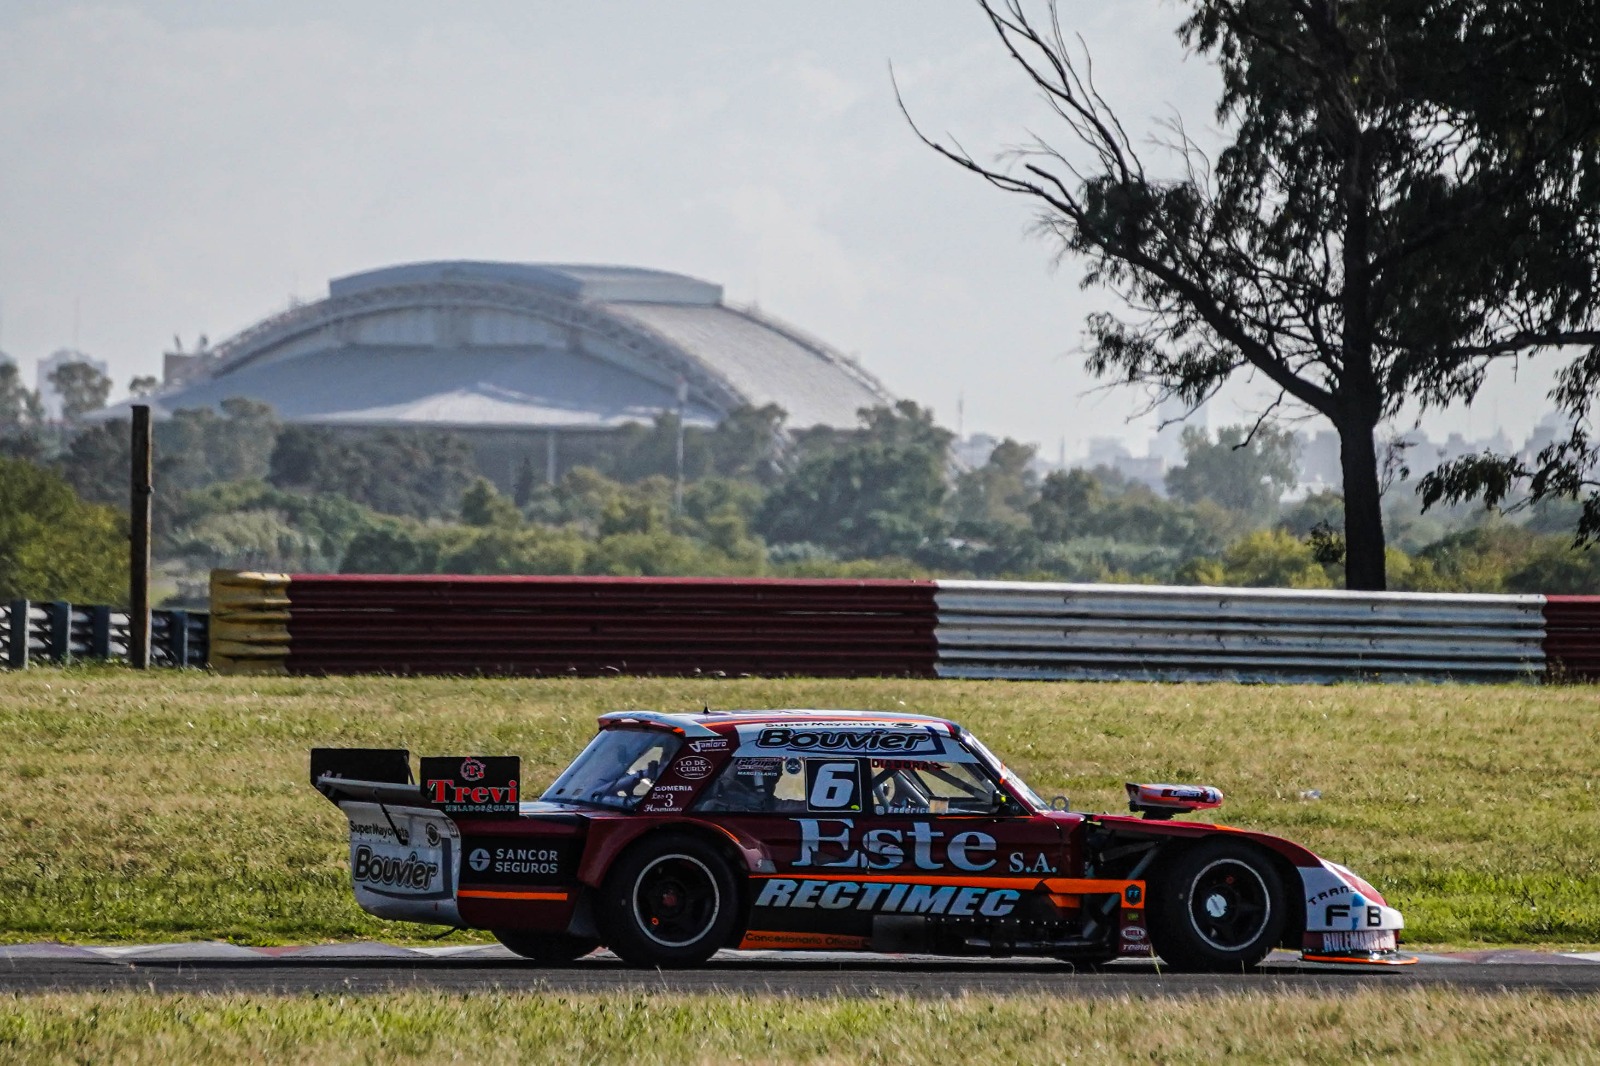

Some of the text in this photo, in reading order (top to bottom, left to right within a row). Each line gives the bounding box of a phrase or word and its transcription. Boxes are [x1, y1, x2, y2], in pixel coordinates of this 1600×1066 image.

[756, 729, 930, 750] Bouvier
[427, 779, 518, 803] Trevi
[810, 763, 856, 808] 6
[664, 793, 674, 808] 3
[495, 848, 558, 861] SANCOR
[790, 817, 998, 871] Este
[354, 844, 438, 890] Bouvier
[495, 861, 558, 873] SEGUROS
[1009, 851, 1058, 874] S.A.
[755, 879, 1020, 916] RECTIMEC
[1308, 885, 1355, 905] TRAN
